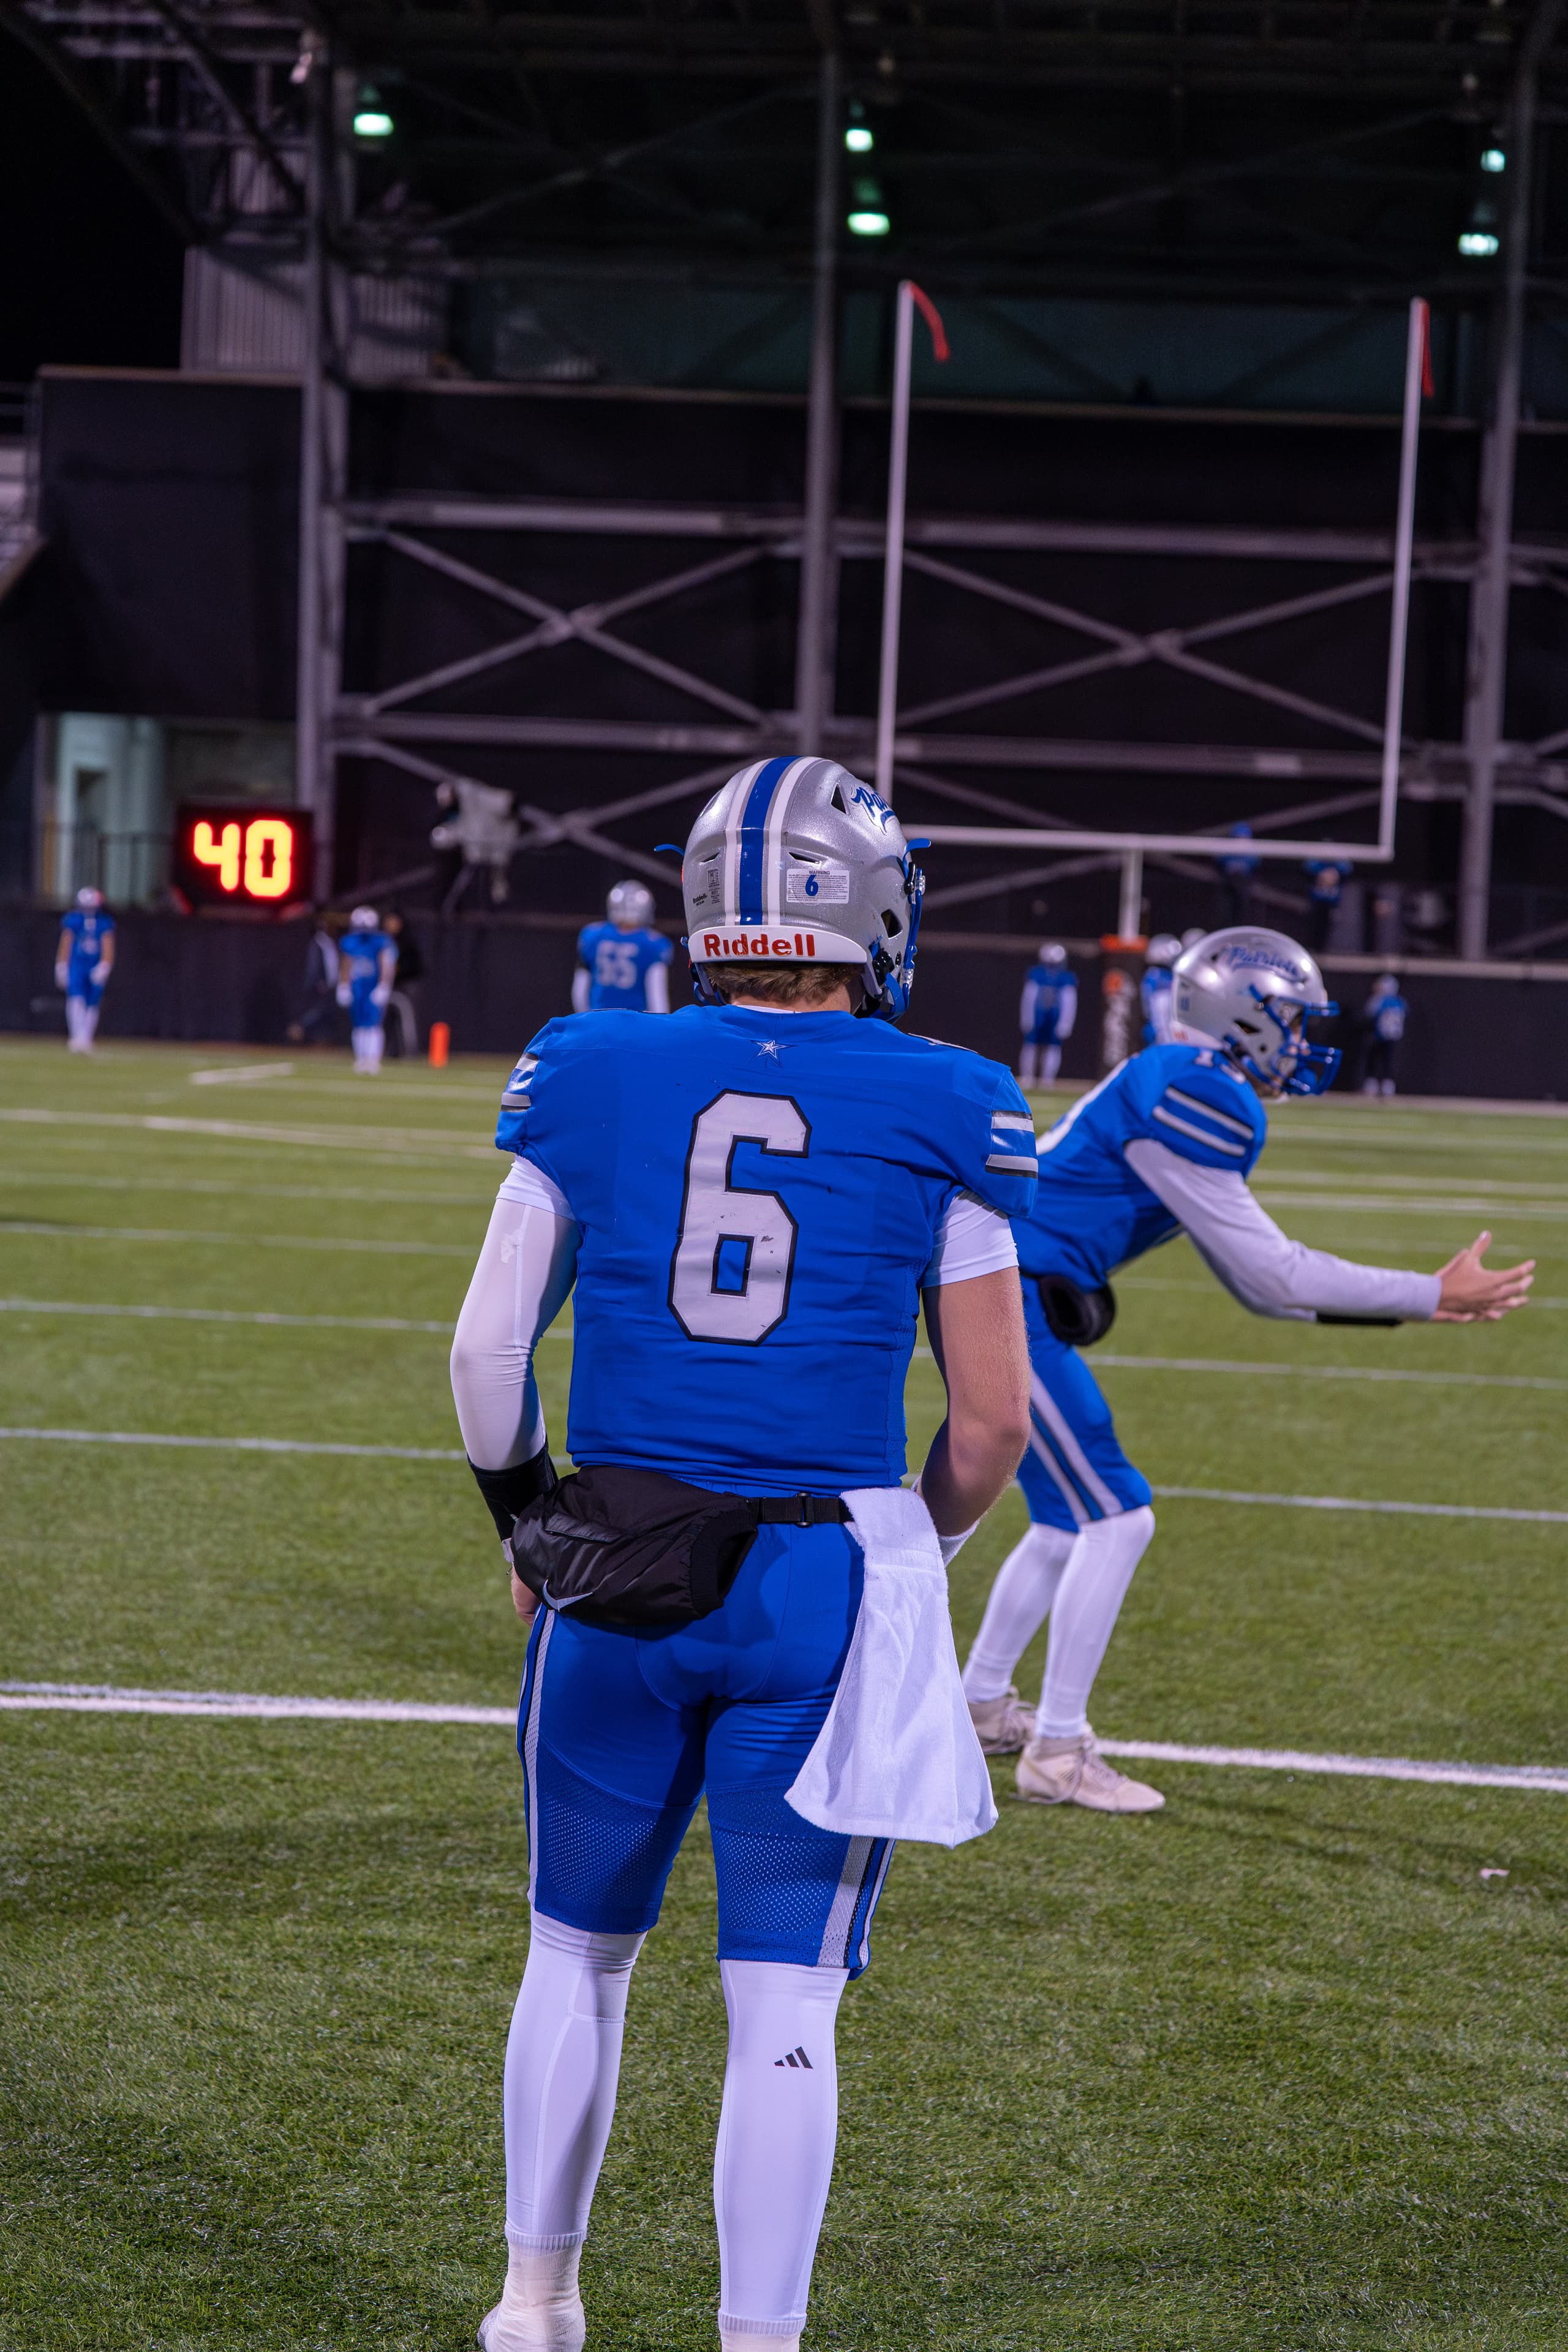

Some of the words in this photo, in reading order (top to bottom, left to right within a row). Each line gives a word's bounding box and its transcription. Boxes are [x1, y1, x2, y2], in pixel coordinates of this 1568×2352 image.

[193, 820, 292, 897] 40
[805, 874, 819, 897] 6
[704, 933, 815, 957] Riddell
[667, 1088, 812, 1347] 6
